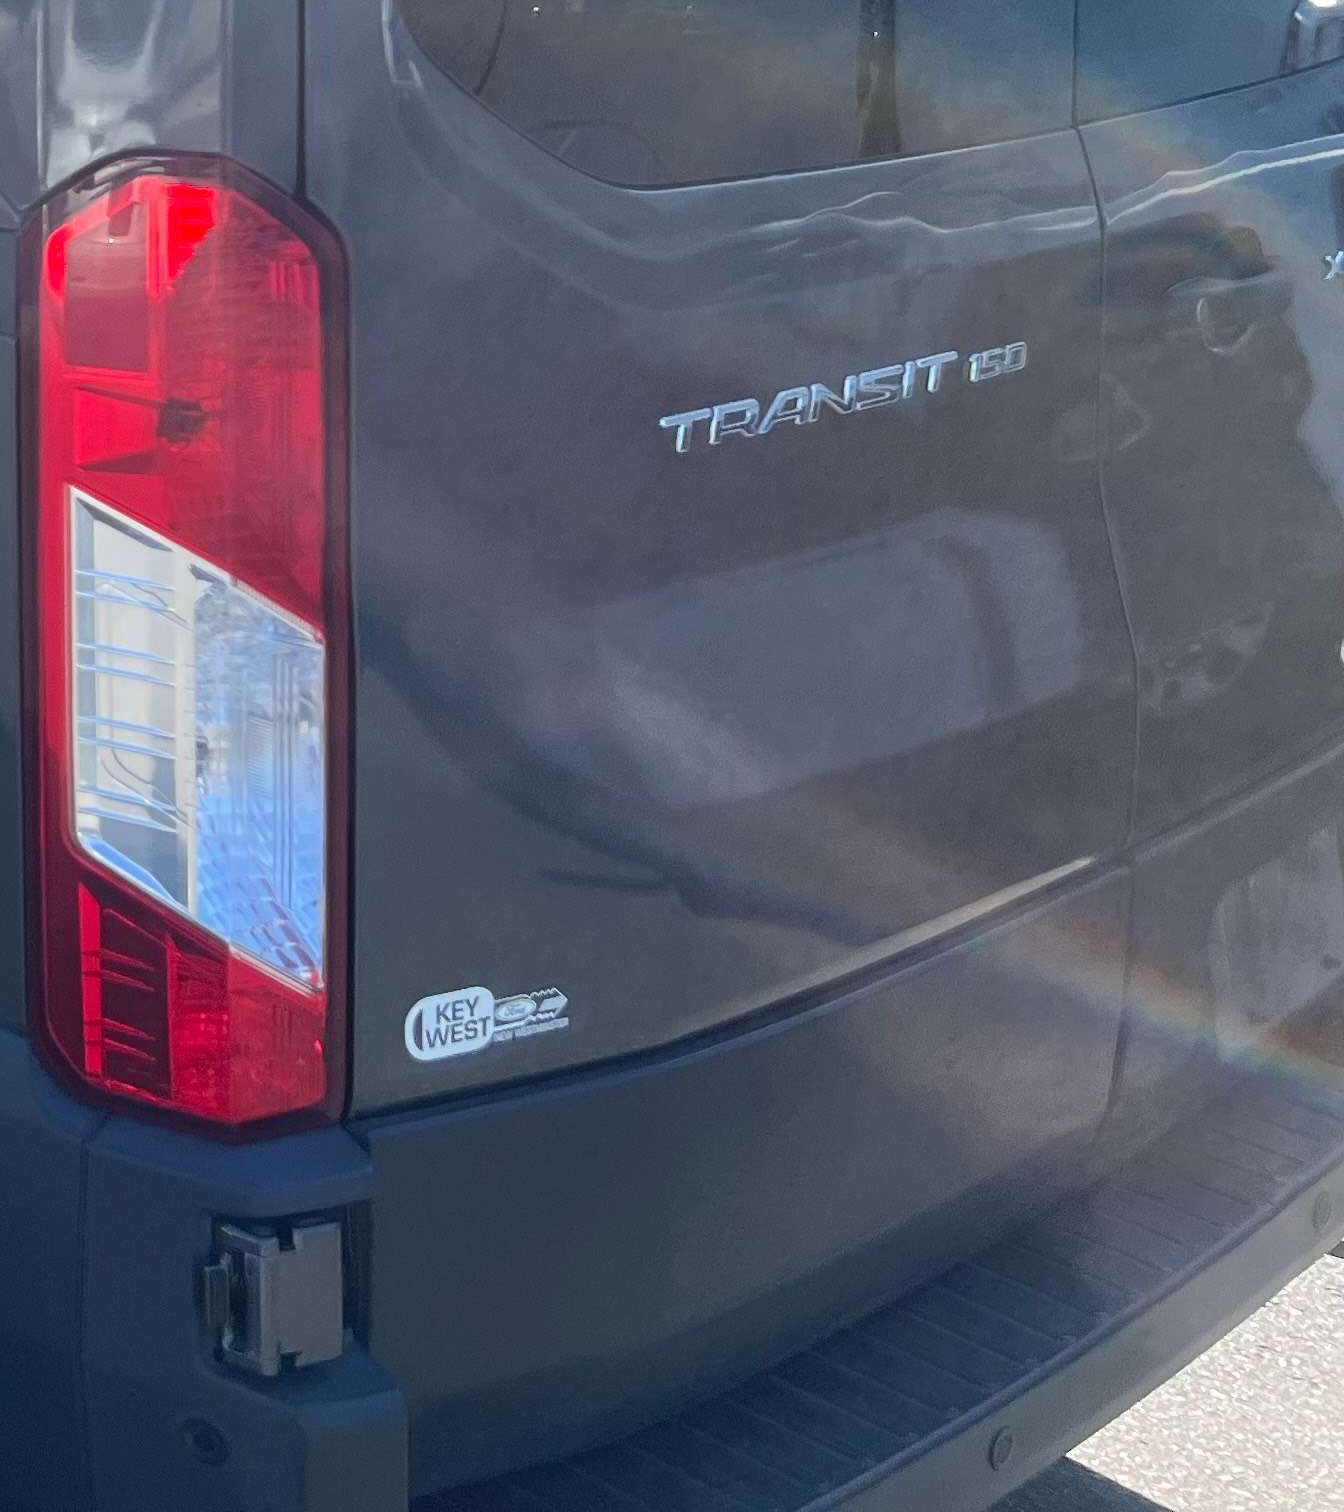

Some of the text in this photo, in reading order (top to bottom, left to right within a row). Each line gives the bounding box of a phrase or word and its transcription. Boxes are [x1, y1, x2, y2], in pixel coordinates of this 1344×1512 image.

[658, 341, 1028, 454] TRANSIT 150
[436, 995, 480, 1025] KEY
[425, 1016, 492, 1048] WEST
